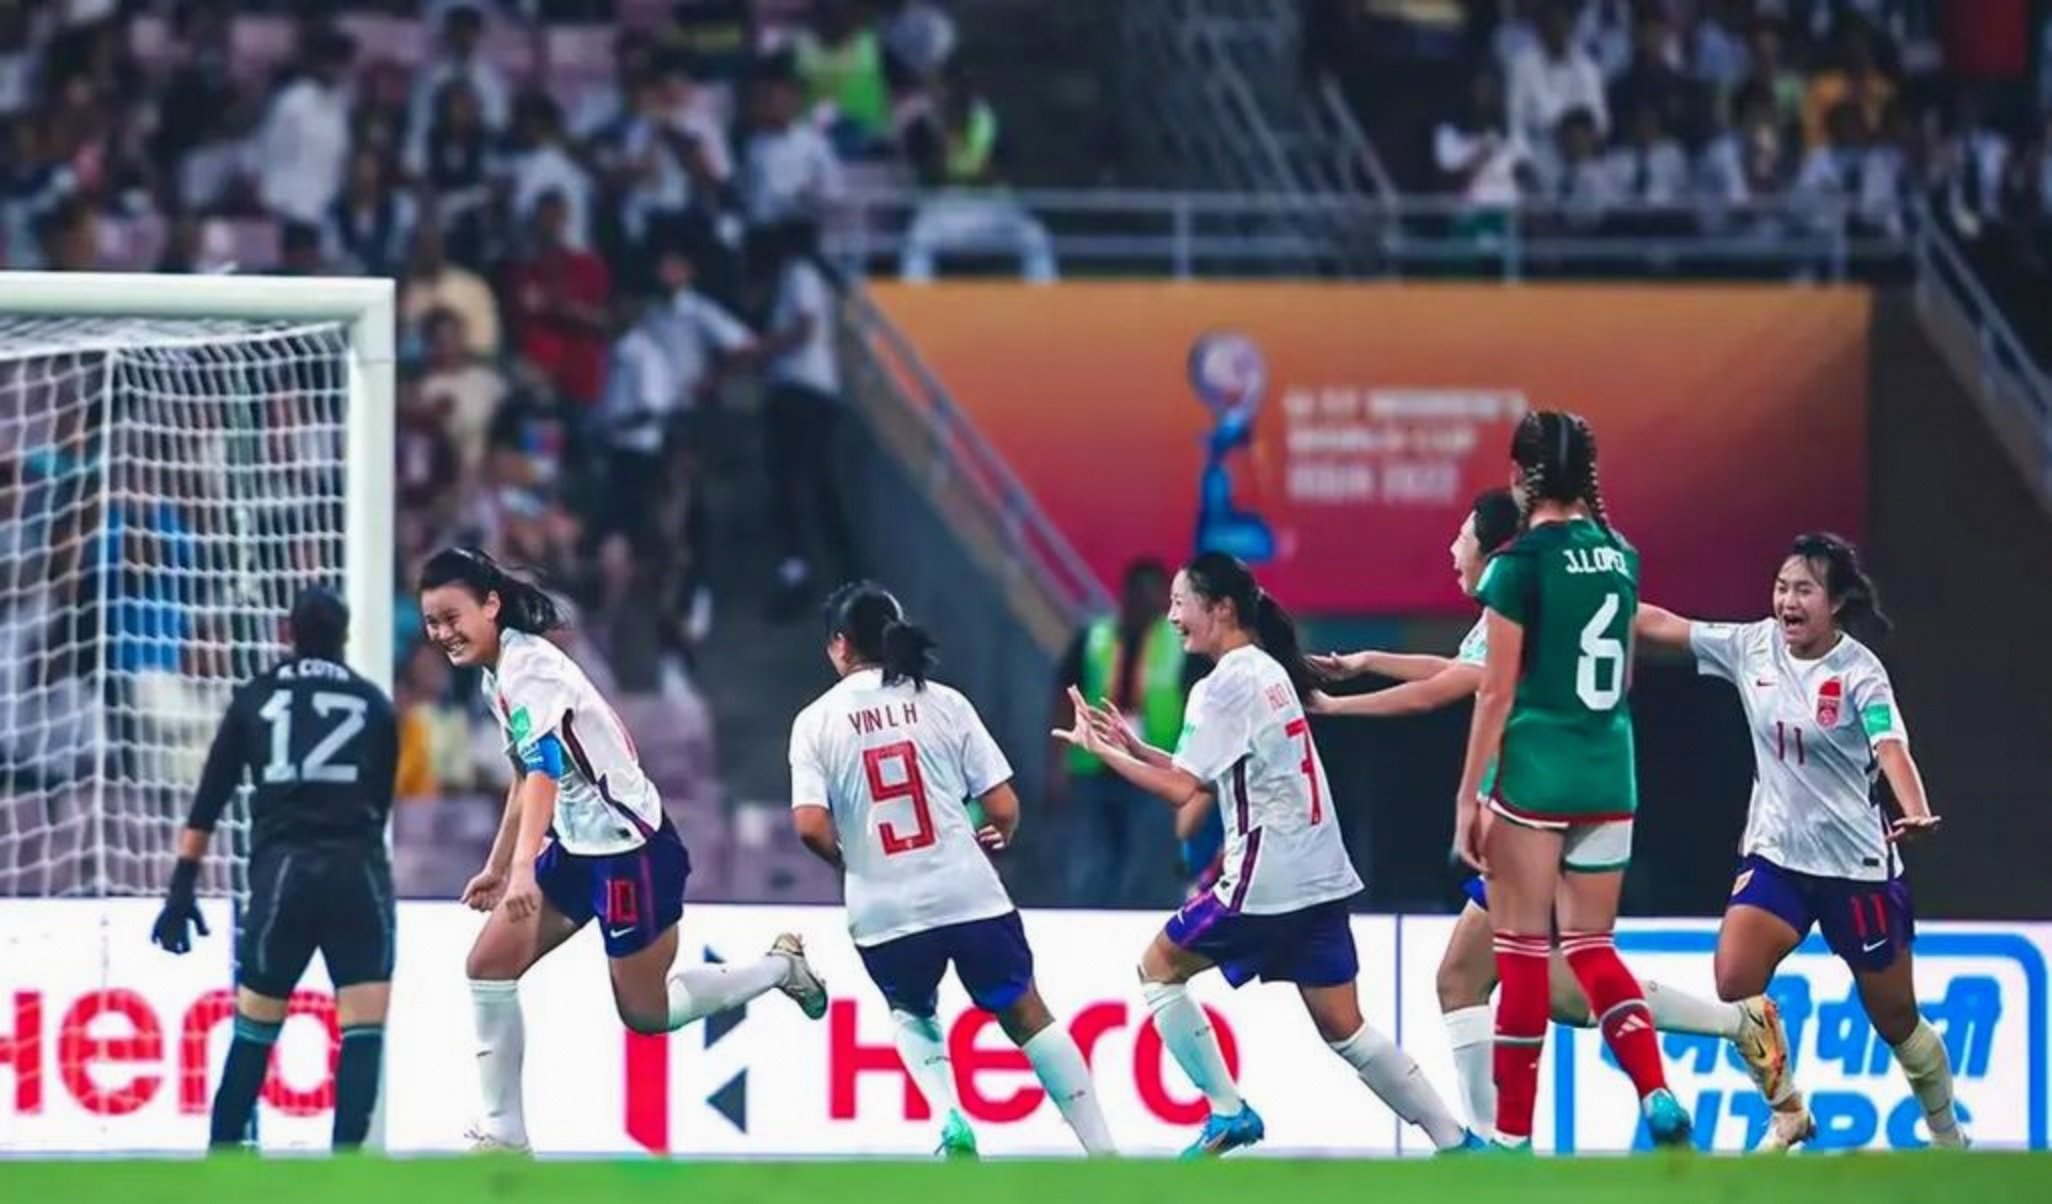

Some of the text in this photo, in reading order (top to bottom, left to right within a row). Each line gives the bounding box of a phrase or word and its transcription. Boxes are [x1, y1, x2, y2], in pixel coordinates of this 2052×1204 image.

[1576, 593, 1624, 711] 6
[259, 689, 368, 782] 12
[1776, 720, 1804, 766] 11
[863, 740, 936, 856] 9
[606, 878, 638, 923] 10
[1851, 894, 1888, 939] 11
[828, 998, 1238, 1126] Hero
